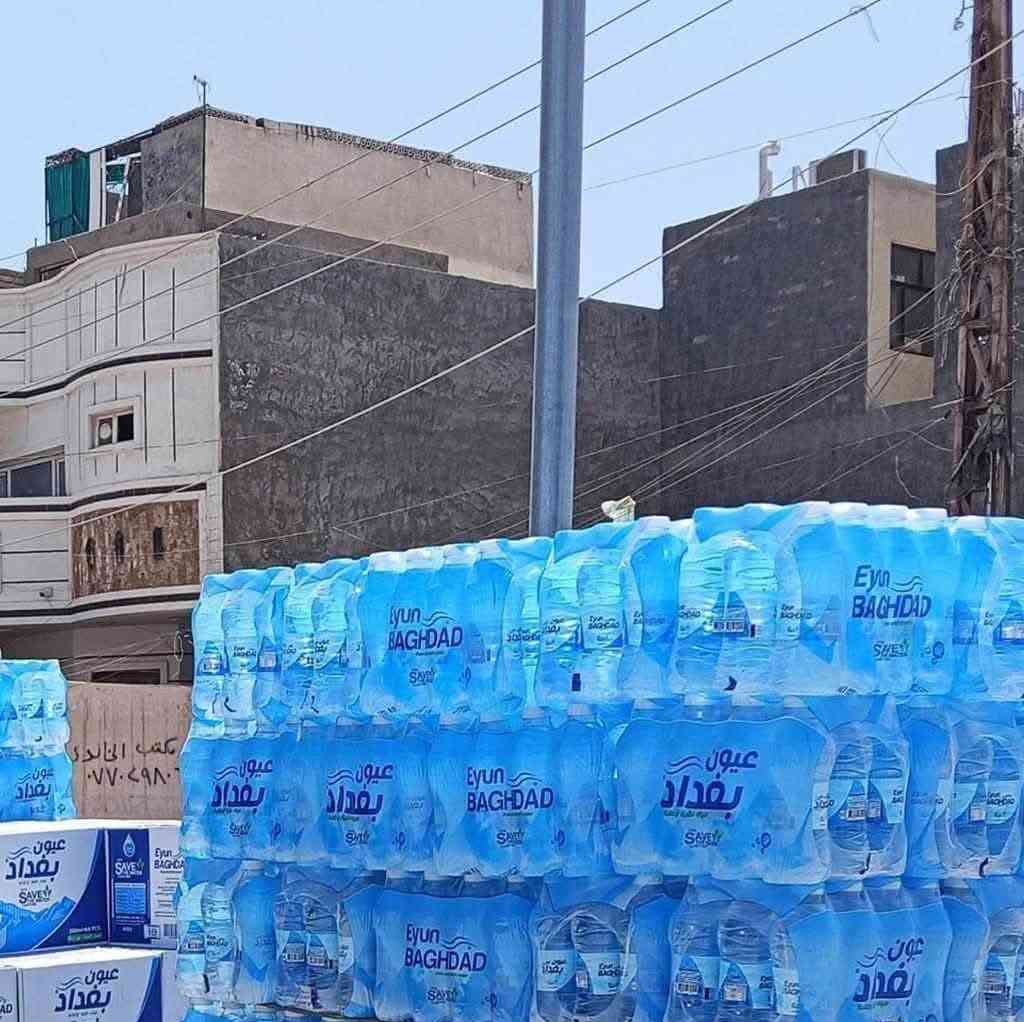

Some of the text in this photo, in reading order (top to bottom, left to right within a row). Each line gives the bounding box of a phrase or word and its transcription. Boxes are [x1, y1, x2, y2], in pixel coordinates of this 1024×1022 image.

[852, 594, 931, 620] BAGHDAD
[388, 625, 463, 651] BAGHDAD
[240, 759, 272, 778] عيون
[705, 749, 759, 770] عيون
[356, 764, 393, 785] عيون
[468, 768, 504, 791] Eyun
[211, 780, 265, 814] بغداد
[327, 784, 384, 821] بغداد
[468, 787, 553, 812] BAGHDAD
[661, 772, 744, 819] بغداد
[33, 839, 66, 855] عيون
[5, 855, 60, 883] بغداد
[154, 859, 184, 870] BAGHDA
[19, 889, 44, 904] SAVE
[406, 924, 439, 948] Eyun
[405, 948, 486, 972] BAGHDAD
[85, 968, 119, 985] عيون
[54, 985, 112, 1013] بغداد
